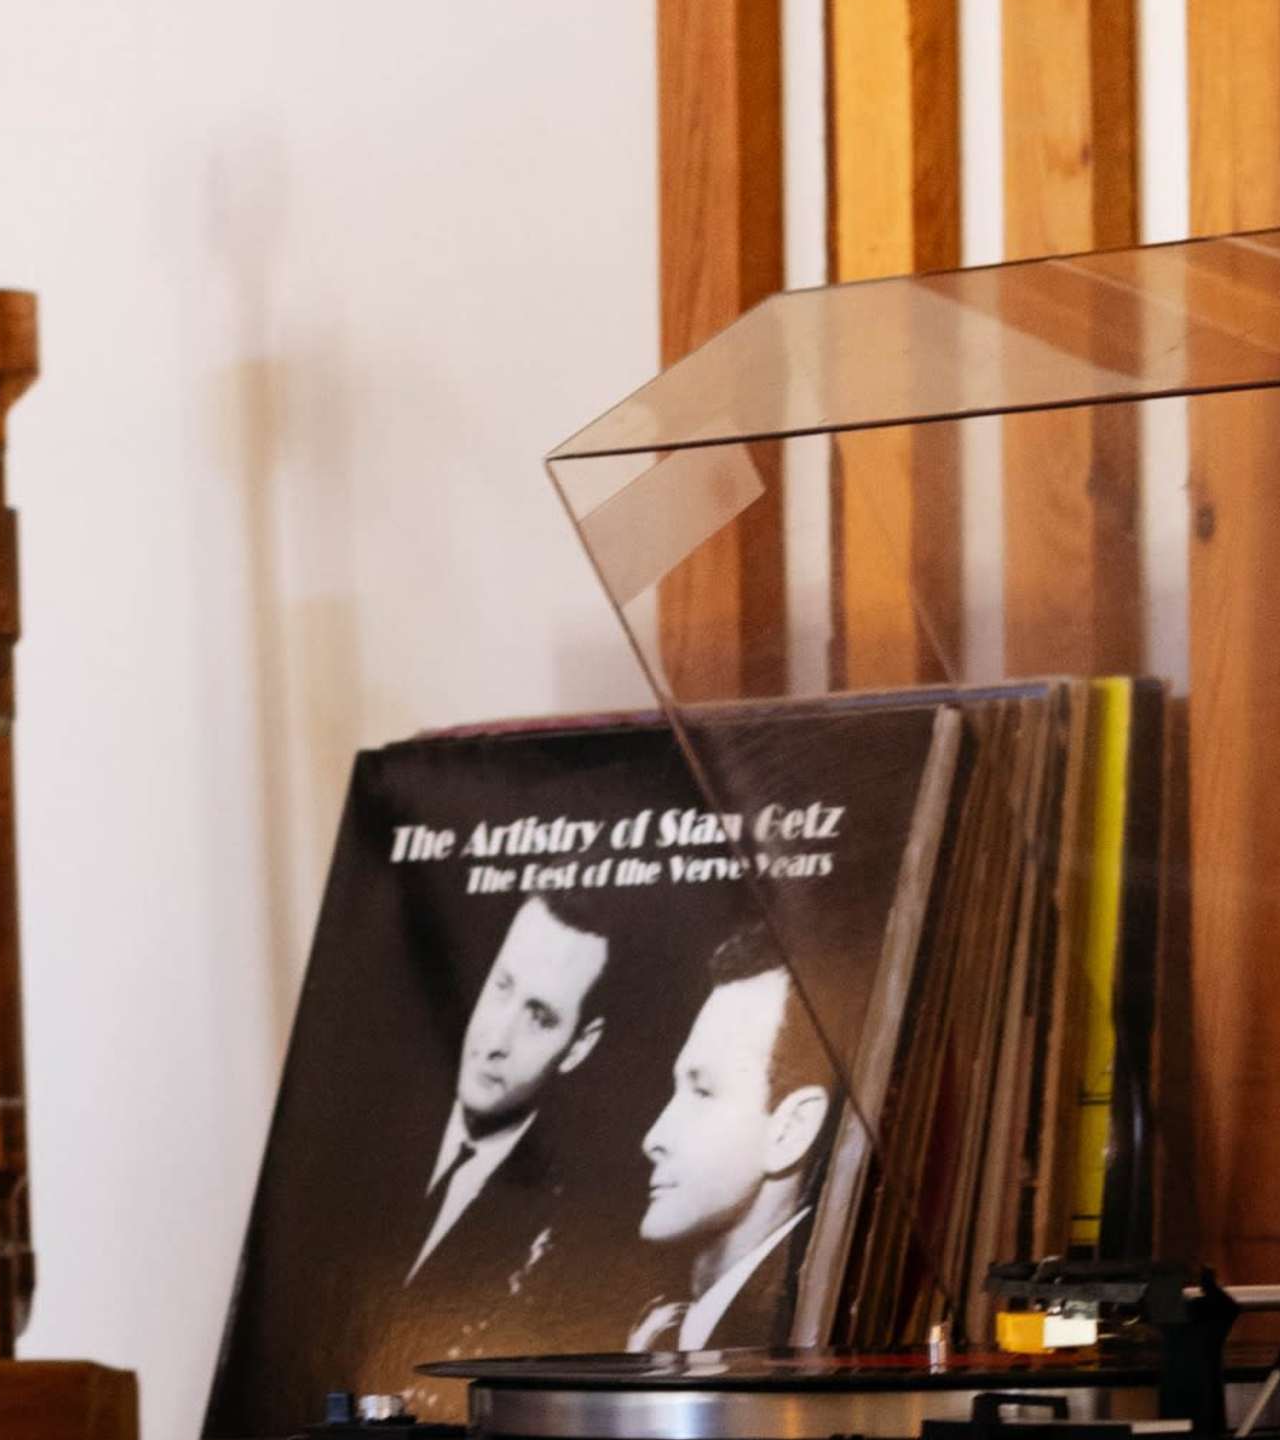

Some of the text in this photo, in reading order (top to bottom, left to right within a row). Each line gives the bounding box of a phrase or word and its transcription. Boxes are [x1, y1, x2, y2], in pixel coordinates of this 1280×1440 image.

[390, 801, 846, 863] The Artistry of Stan Getz
[467, 851, 834, 895] The Best of the Verve Years
